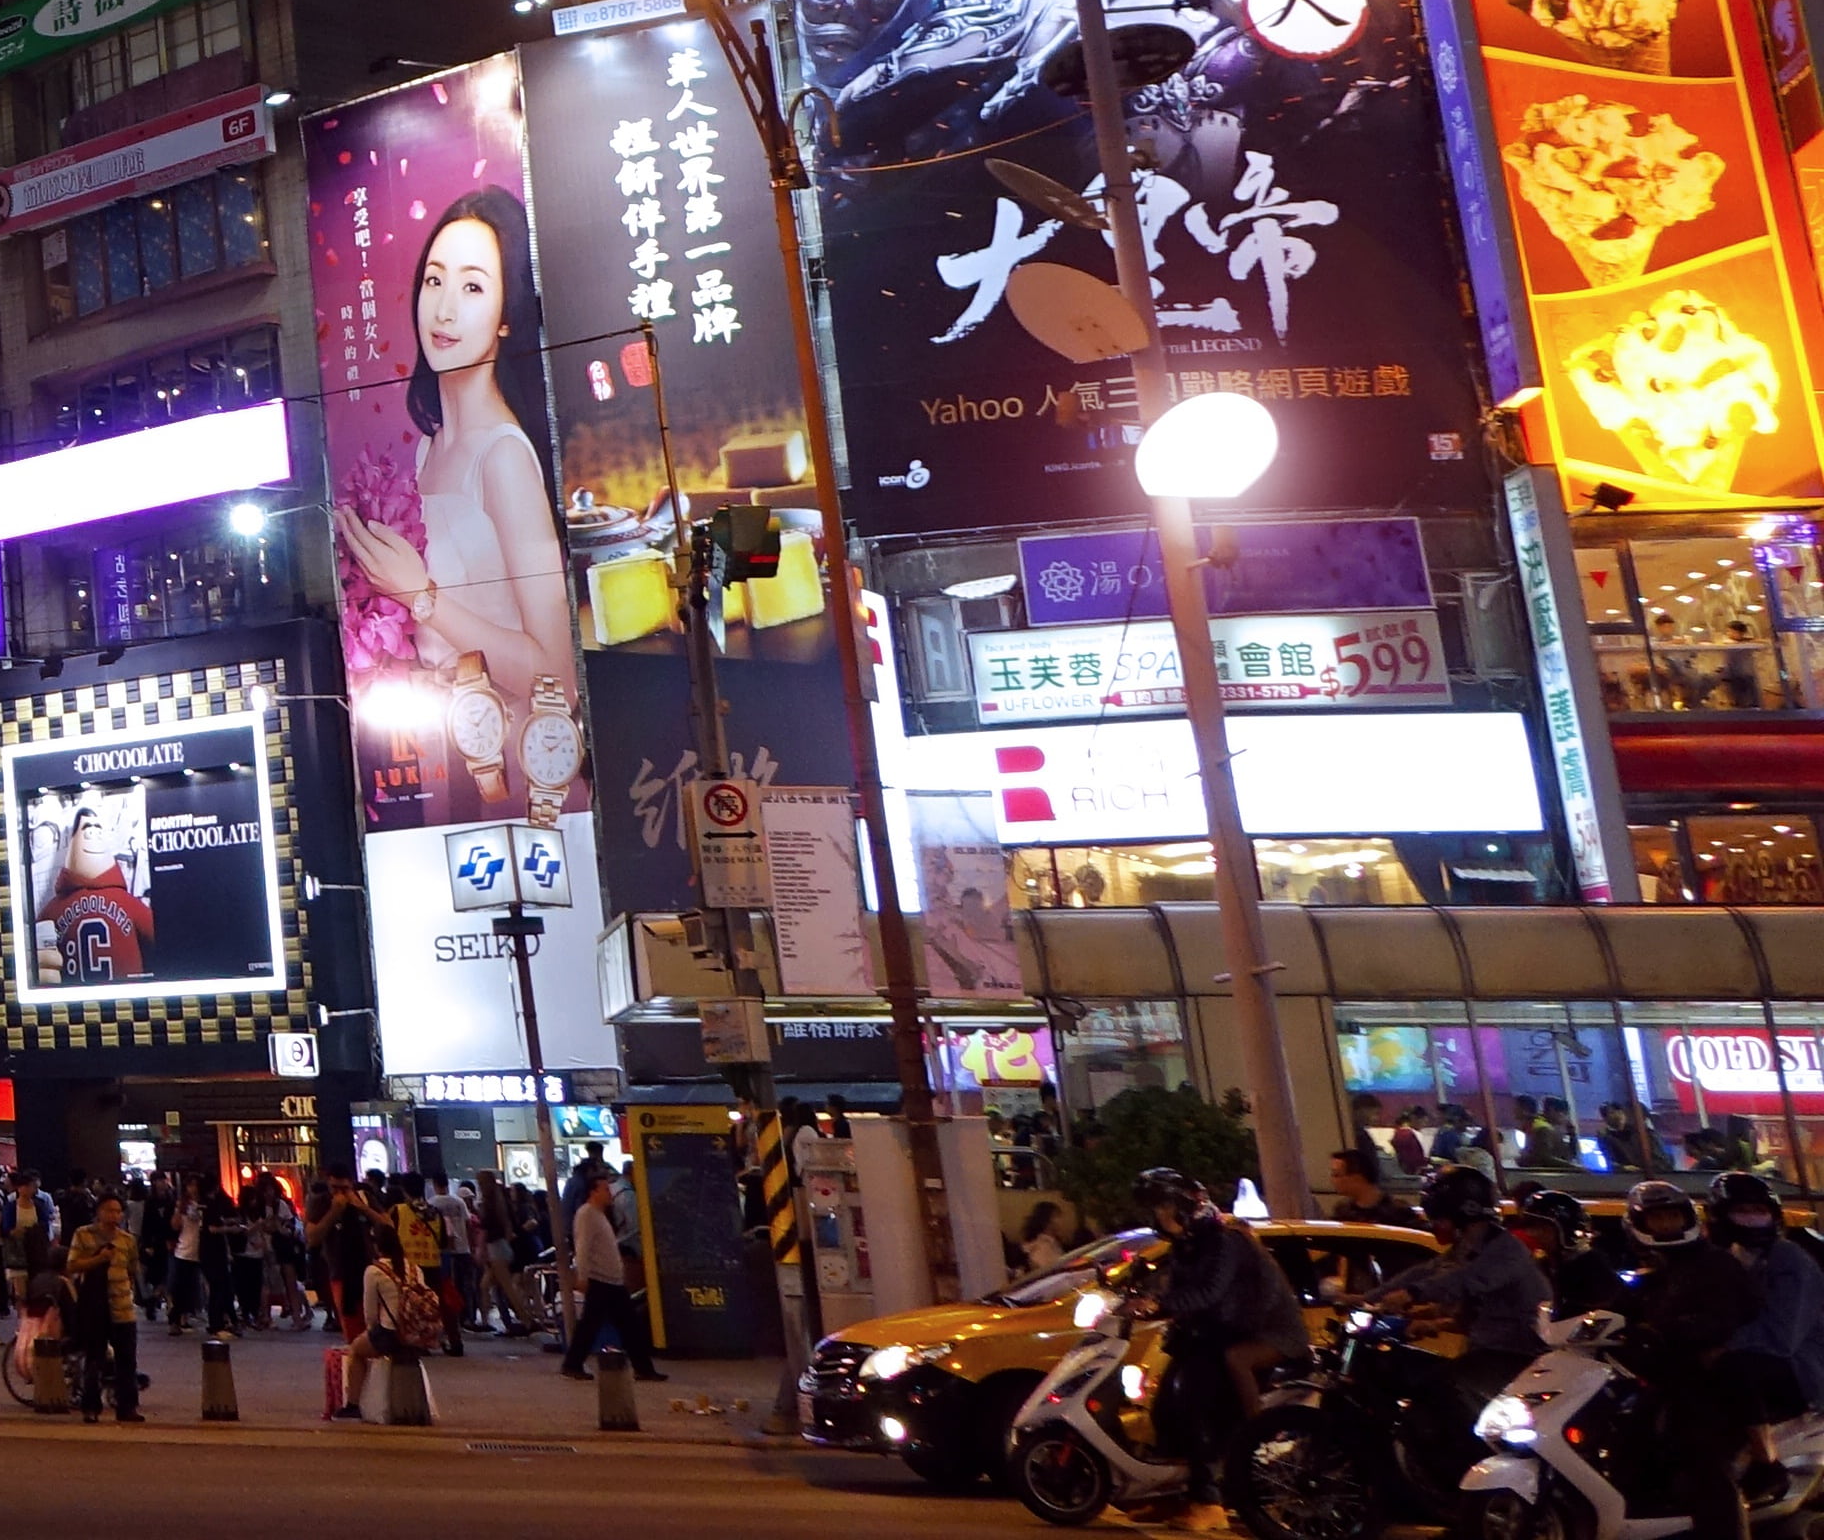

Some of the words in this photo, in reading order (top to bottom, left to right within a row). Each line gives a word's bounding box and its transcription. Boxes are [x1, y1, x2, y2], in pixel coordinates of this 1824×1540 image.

[227, 117, 250, 136] 6F
[1191, 337, 1263, 355] LEGEND
[921, 393, 1024, 427] Yahoo
[1036, 365, 1412, 417] 人氣三戰略網頁遊戲
[988, 652, 1105, 692] 玉芙蓉
[1113, 648, 1180, 683] SPA
[1236, 641, 1316, 678] 會館
[1318, 629, 1431, 703] $599
[1004, 693, 1094, 712] U-FLOWER
[1218, 683, 1302, 701] 2331-5793
[373, 763, 447, 788] LUKIA
[1070, 784, 1171, 813] RICH
[148, 822, 261, 853] :CHOCOOLATE
[433, 931, 541, 963] SEIKO
